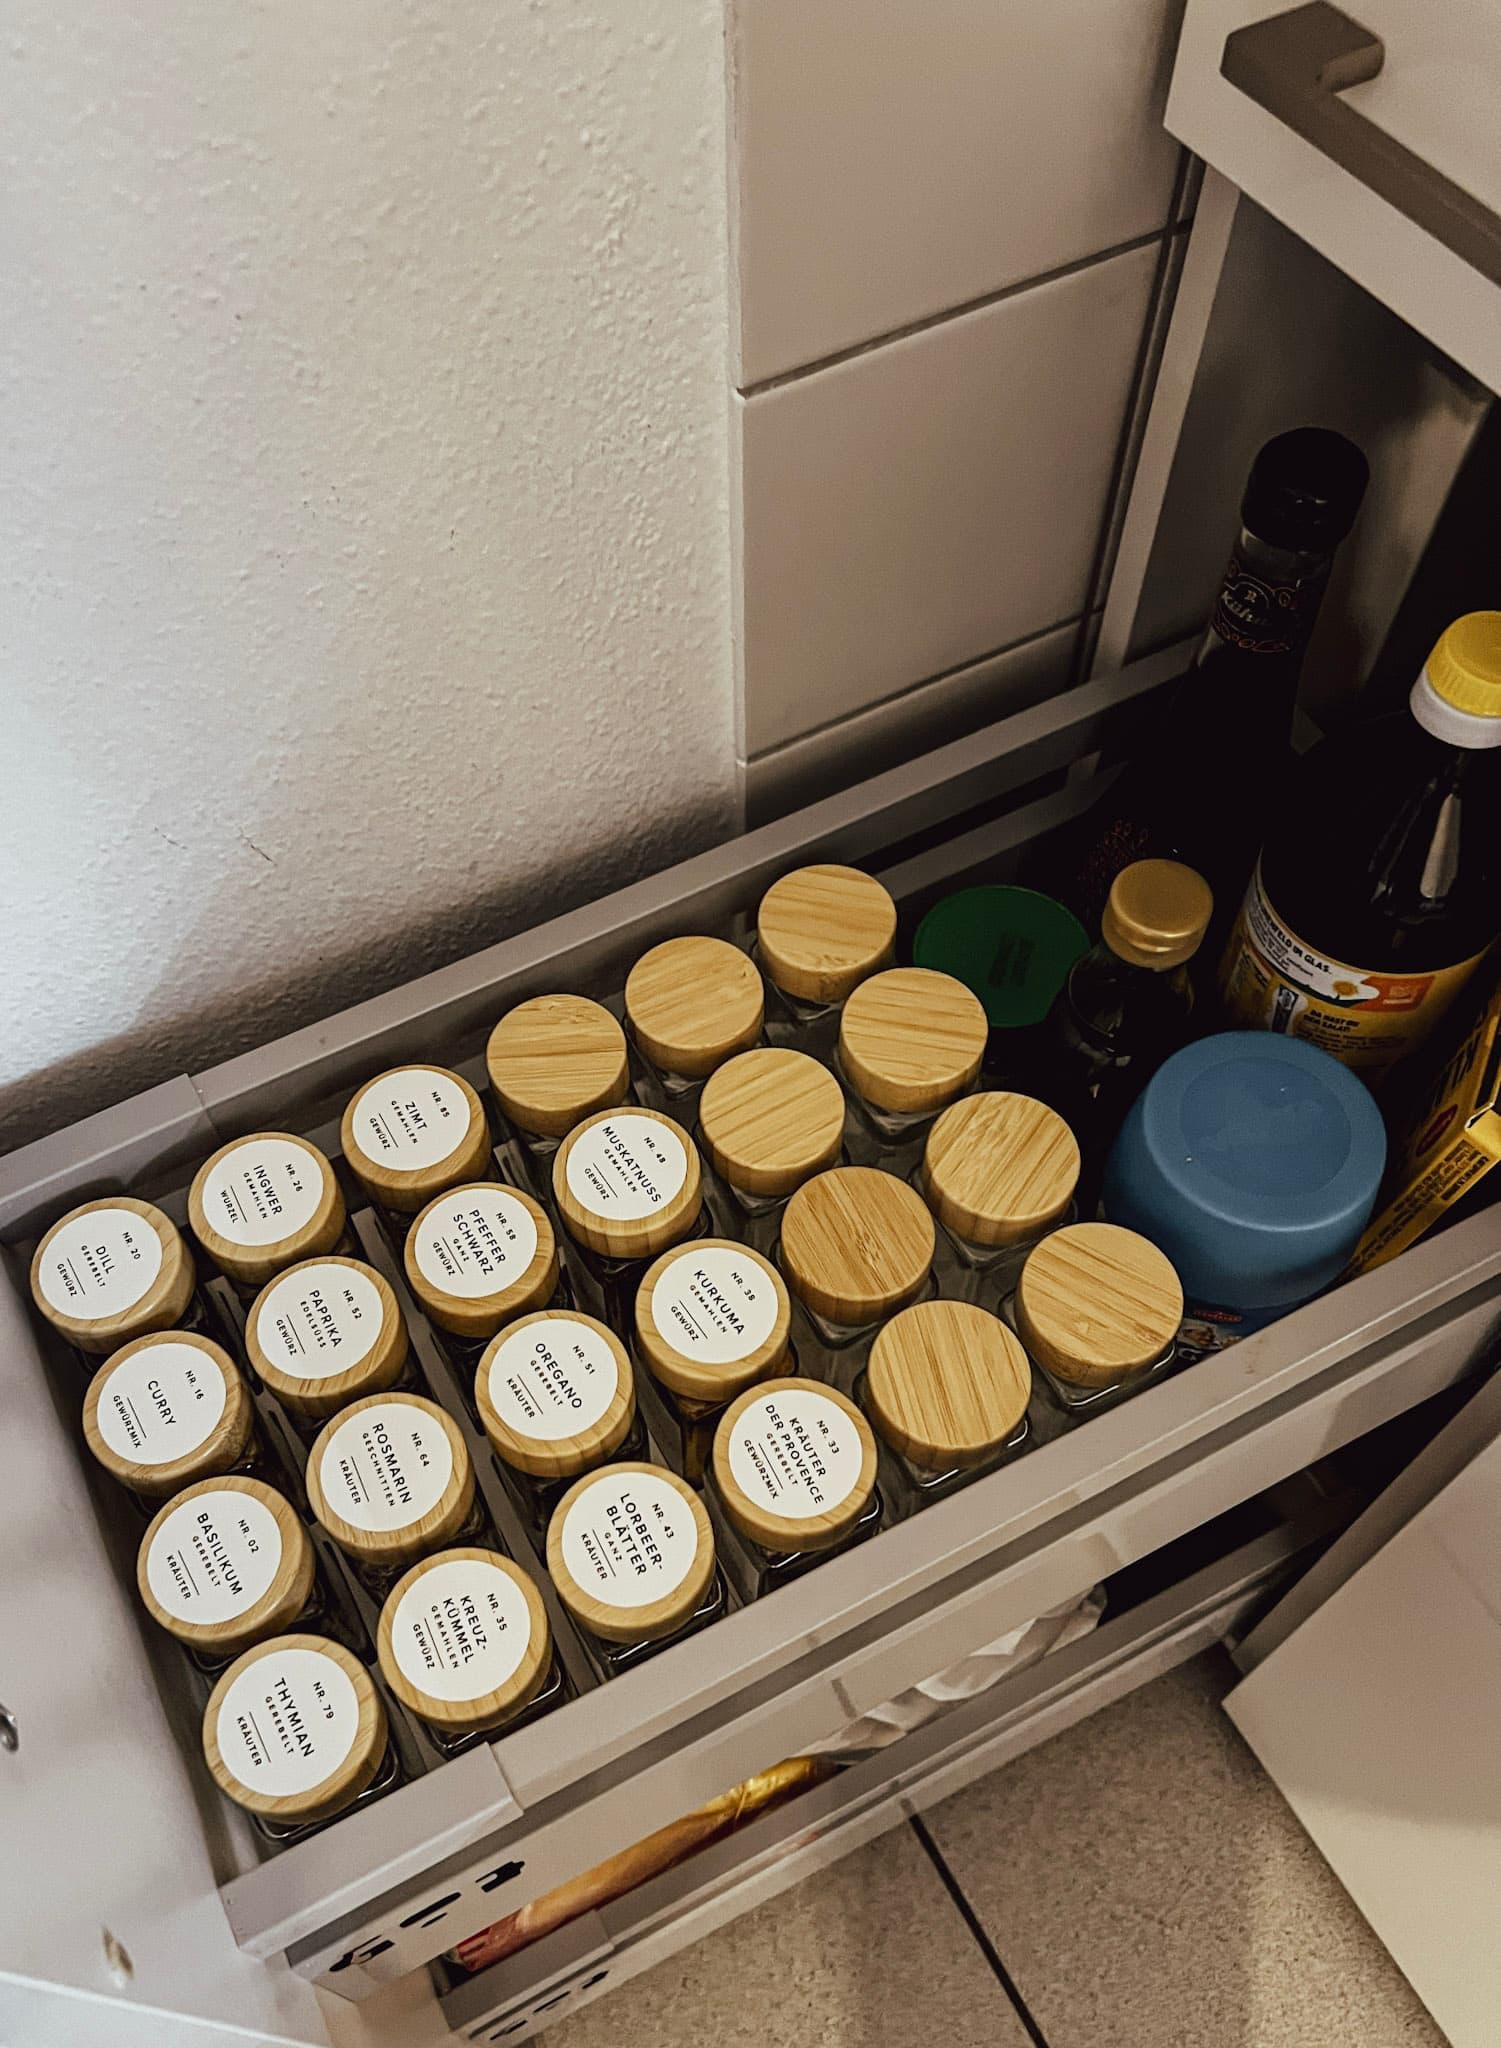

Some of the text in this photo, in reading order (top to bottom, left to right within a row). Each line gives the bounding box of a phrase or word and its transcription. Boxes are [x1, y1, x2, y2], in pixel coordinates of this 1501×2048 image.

[391, 1100, 418, 1144] GEMAHLEN
[405, 1101, 427, 1130] ZIMT
[431, 1091, 450, 1118] NR. 85
[369, 1118, 391, 1150] GEWÜRZ
[644, 1137, 666, 1163] NR. 48
[285, 1163, 303, 1192] NR. 26
[584, 1168, 610, 1200] GEWÜRZ
[602, 1126, 661, 1202] MUSKATNUSS
[604, 1149, 637, 1192] GEMAHLEN
[220, 1190, 238, 1224] WURZEL
[243, 1172, 268, 1219] GEMAHLEN
[253, 1165, 283, 1215] INGWER
[122, 1232, 141, 1260] NR. 20
[453, 1214, 494, 1275] SCHWARZ
[469, 1209, 506, 1264] PFEFFER
[496, 1212, 516, 1240] NR. 58
[81, 1245, 106, 1287] GEREBELT
[95, 1245, 115, 1274] DILL
[433, 1242, 456, 1276] GEWÜRZ
[453, 1238, 469, 1262] GANZ
[57, 1263, 77, 1297] GEWÜRZ
[694, 1270, 744, 1335] KURKUMA
[731, 1272, 755, 1301] NR. 38
[300, 1301, 326, 1348] EDELSÜSS
[309, 1290, 342, 1348] PAPRIKA
[343, 1289, 362, 1319] NR. 52
[671, 1306, 699, 1341] GEWÜRZ
[690, 1285, 727, 1333] GEMAHLEN
[276, 1319, 297, 1356] GEWÜRZ
[573, 1345, 595, 1375] NR. 51
[185, 1370, 204, 1400] NR. 16
[506, 1378, 535, 1418] KRÄUTER
[530, 1360, 563, 1406] GEREBELT
[535, 1343, 582, 1408] OREGANO
[113, 1395, 142, 1448] GEWÜRZMIX
[148, 1380, 176, 1425] CURRY
[411, 1432, 430, 1467] NR. 64
[765, 1404, 824, 1504] DER PROVENCE
[766, 1433, 798, 1484] GEREBELT
[789, 1417, 826, 1477] KRÄUTER
[817, 1420, 840, 1454] NR. 33
[339, 1459, 361, 1504] KRÄUTER
[362, 1433, 395, 1507] GESCHNITTEN
[372, 1423, 412, 1504] ROSMARIN
[744, 1440, 779, 1499] GEWÜRZMIX
[238, 1519, 259, 1553] NR. 02
[606, 1505, 647, 1576] BLÄTTER
[620, 1493, 662, 1570] LORBEER-
[652, 1503, 674, 1538] NR. 43
[192, 1536, 221, 1587] GEREBELT
[197, 1512, 243, 1595] BASILIKUM
[581, 1533, 608, 1580] KRÄUTER
[604, 1532, 622, 1561] GANZ
[166, 1555, 191, 1600] KRÄUTER
[443, 1598, 474, 1664] KÜMMEL
[460, 1595, 487, 1650] KREUZ-
[487, 1593, 507, 1631] NR. 35
[413, 1624, 435, 1669] GEWÜRZ
[431, 1605, 459, 1669] GEMAHLEN
[274, 1677, 315, 1757] THYMIAN
[313, 1681, 334, 1719] NR. 79
[237, 1716, 262, 1766] KRÄUTER
[265, 1696, 294, 1754] GEREBELT
